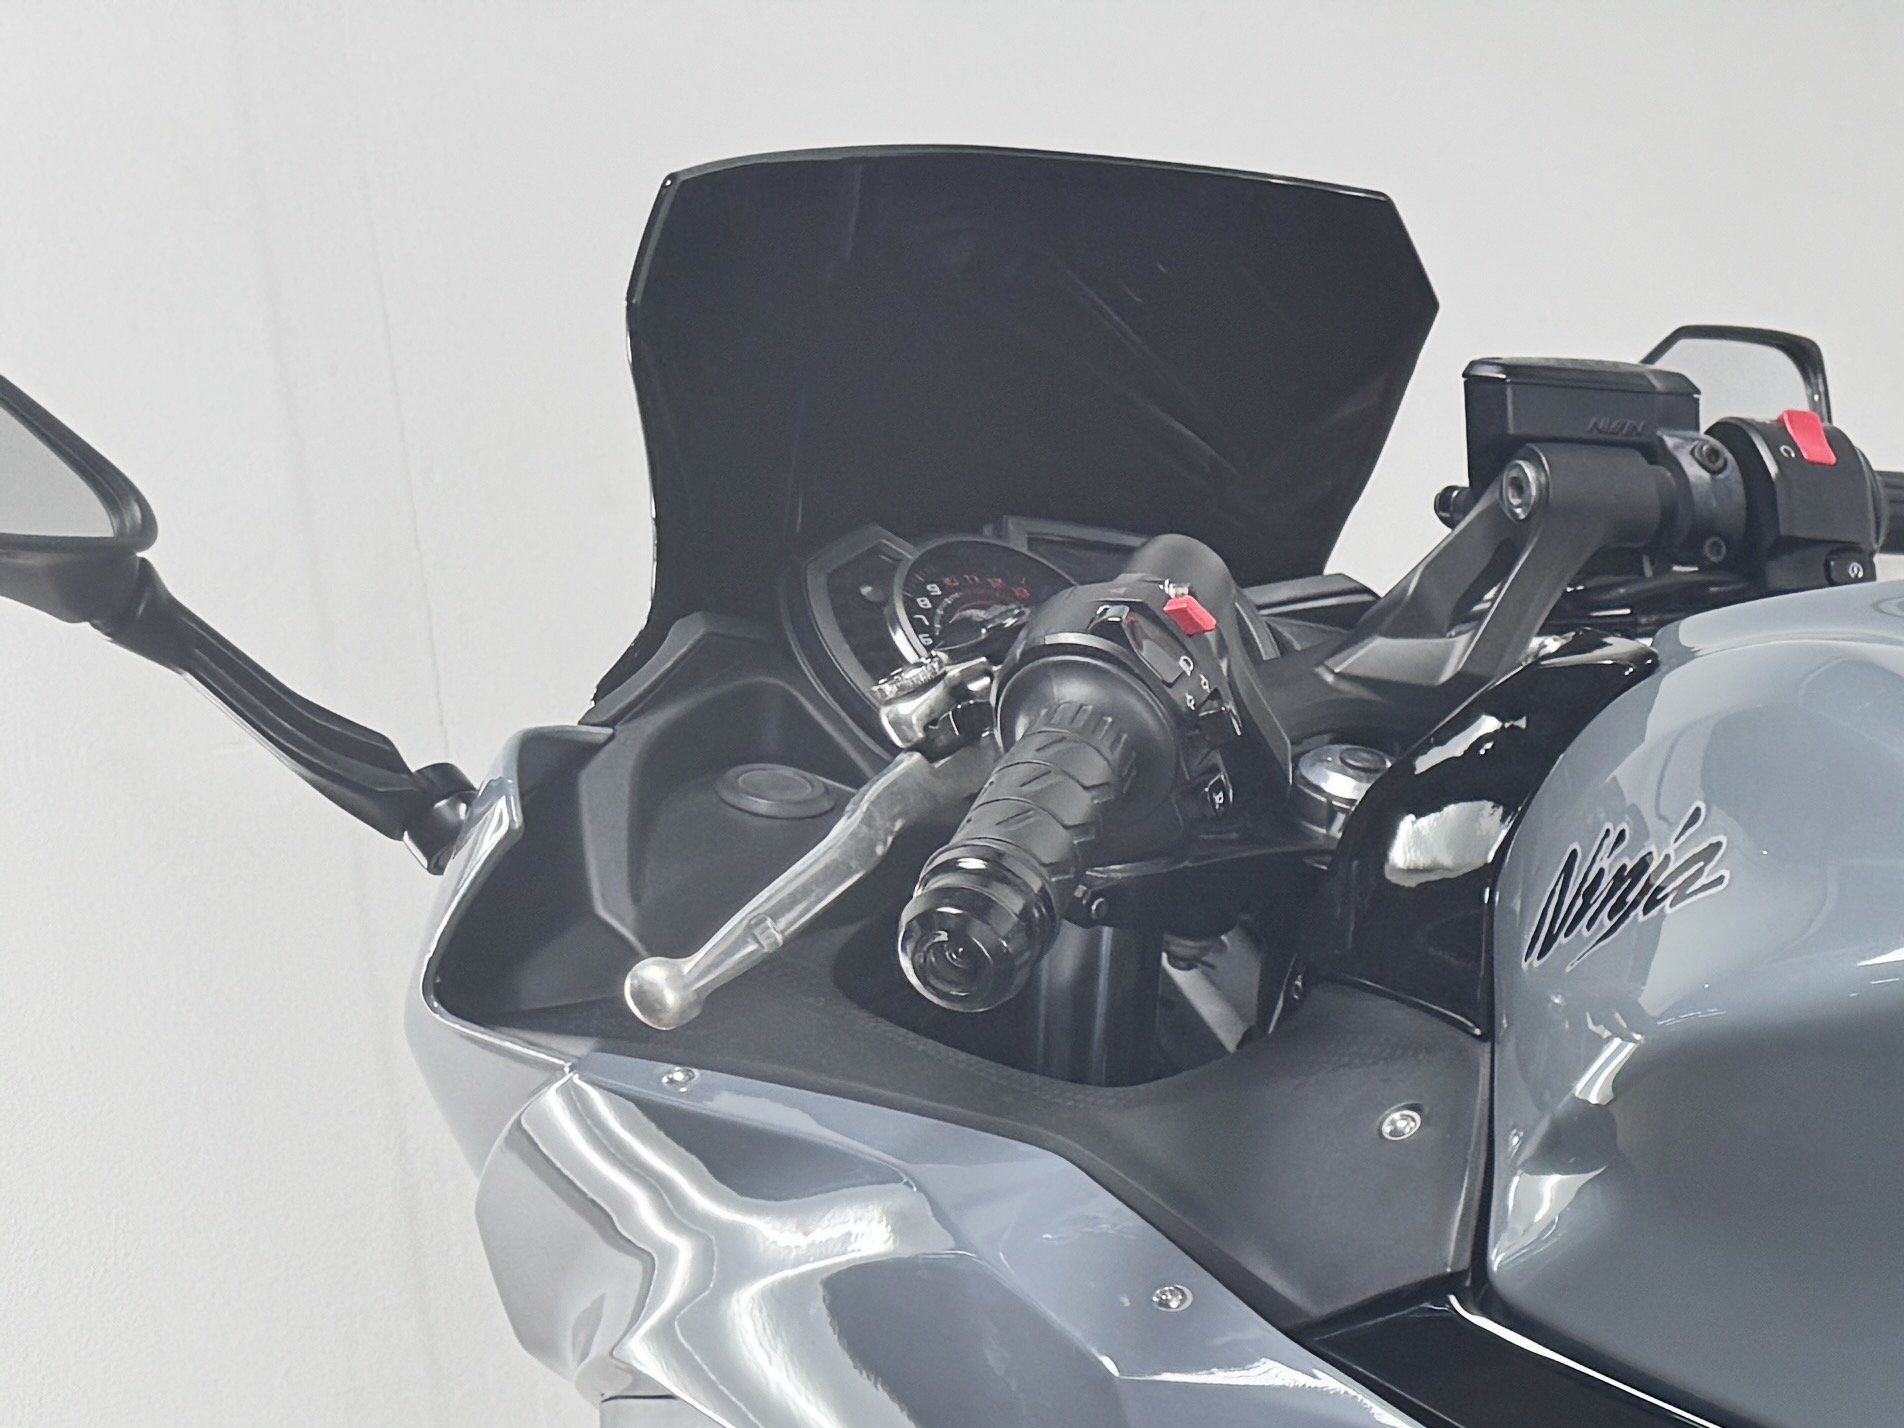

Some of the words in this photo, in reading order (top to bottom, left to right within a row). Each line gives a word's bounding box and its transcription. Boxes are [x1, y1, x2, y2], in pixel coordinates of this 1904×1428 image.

[926, 583, 942, 595] 9
[916, 597, 932, 609] 8
[1521, 800, 1731, 973] Ninja
